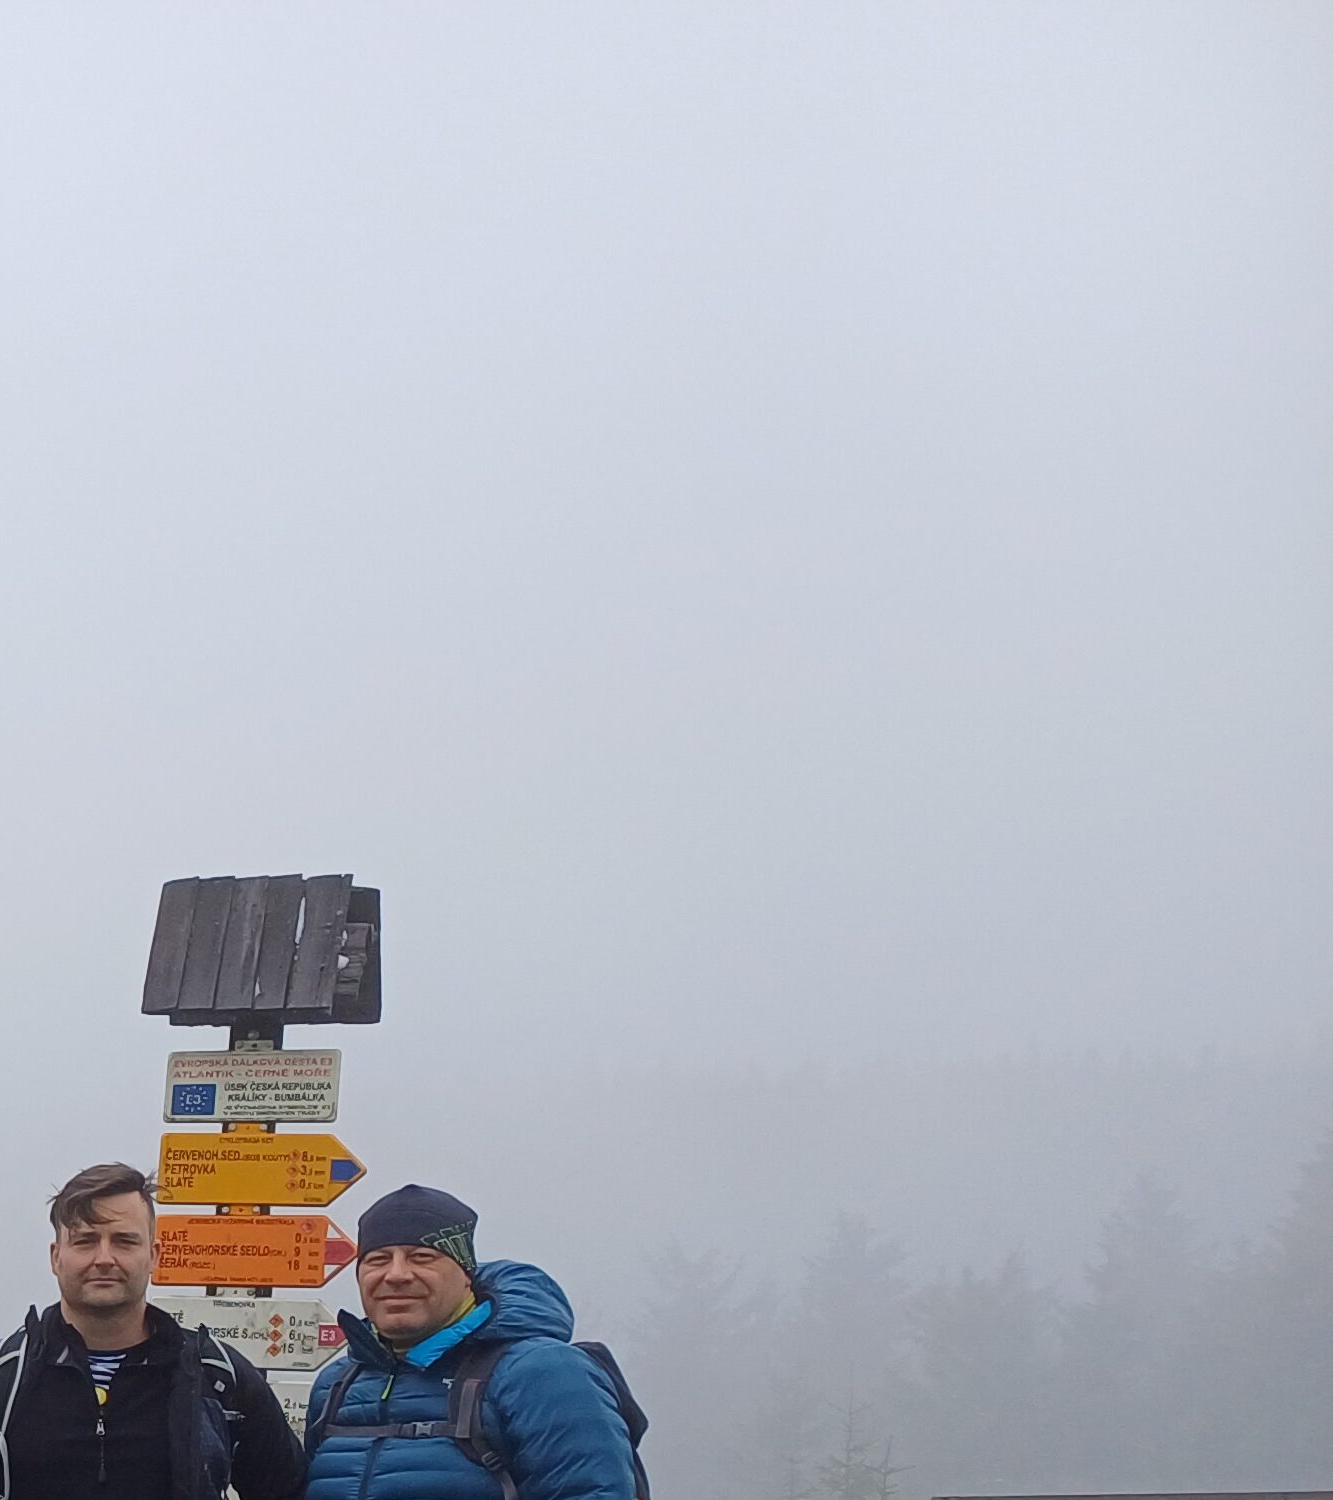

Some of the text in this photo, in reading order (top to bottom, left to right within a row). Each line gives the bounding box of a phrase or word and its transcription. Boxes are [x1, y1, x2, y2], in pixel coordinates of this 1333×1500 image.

[172, 1056, 333, 1068] EVROPSKÁ DÁLKOVÁ CESTA E3
[172, 1068, 234, 1079] ATLANTIK
[293, 1067, 332, 1077] MOŘE
[224, 1080, 332, 1092] ÚSEK ČESKÁ REPUBLIKA
[185, 1094, 202, 1105] E3
[228, 1091, 266, 1102] KRÁLÍKY
[274, 1091, 326, 1102] BUMBÁLKA
[164, 1163, 217, 1175] PETROVKA
[239, 1244, 270, 1257] SEDLO
[293, 1246, 301, 1257] 9
[158, 1253, 190, 1269] ŠERÁK
[287, 1259, 301, 1271] 18
[320, 1329, 336, 1342] E3
[282, 1342, 294, 1354] 15
